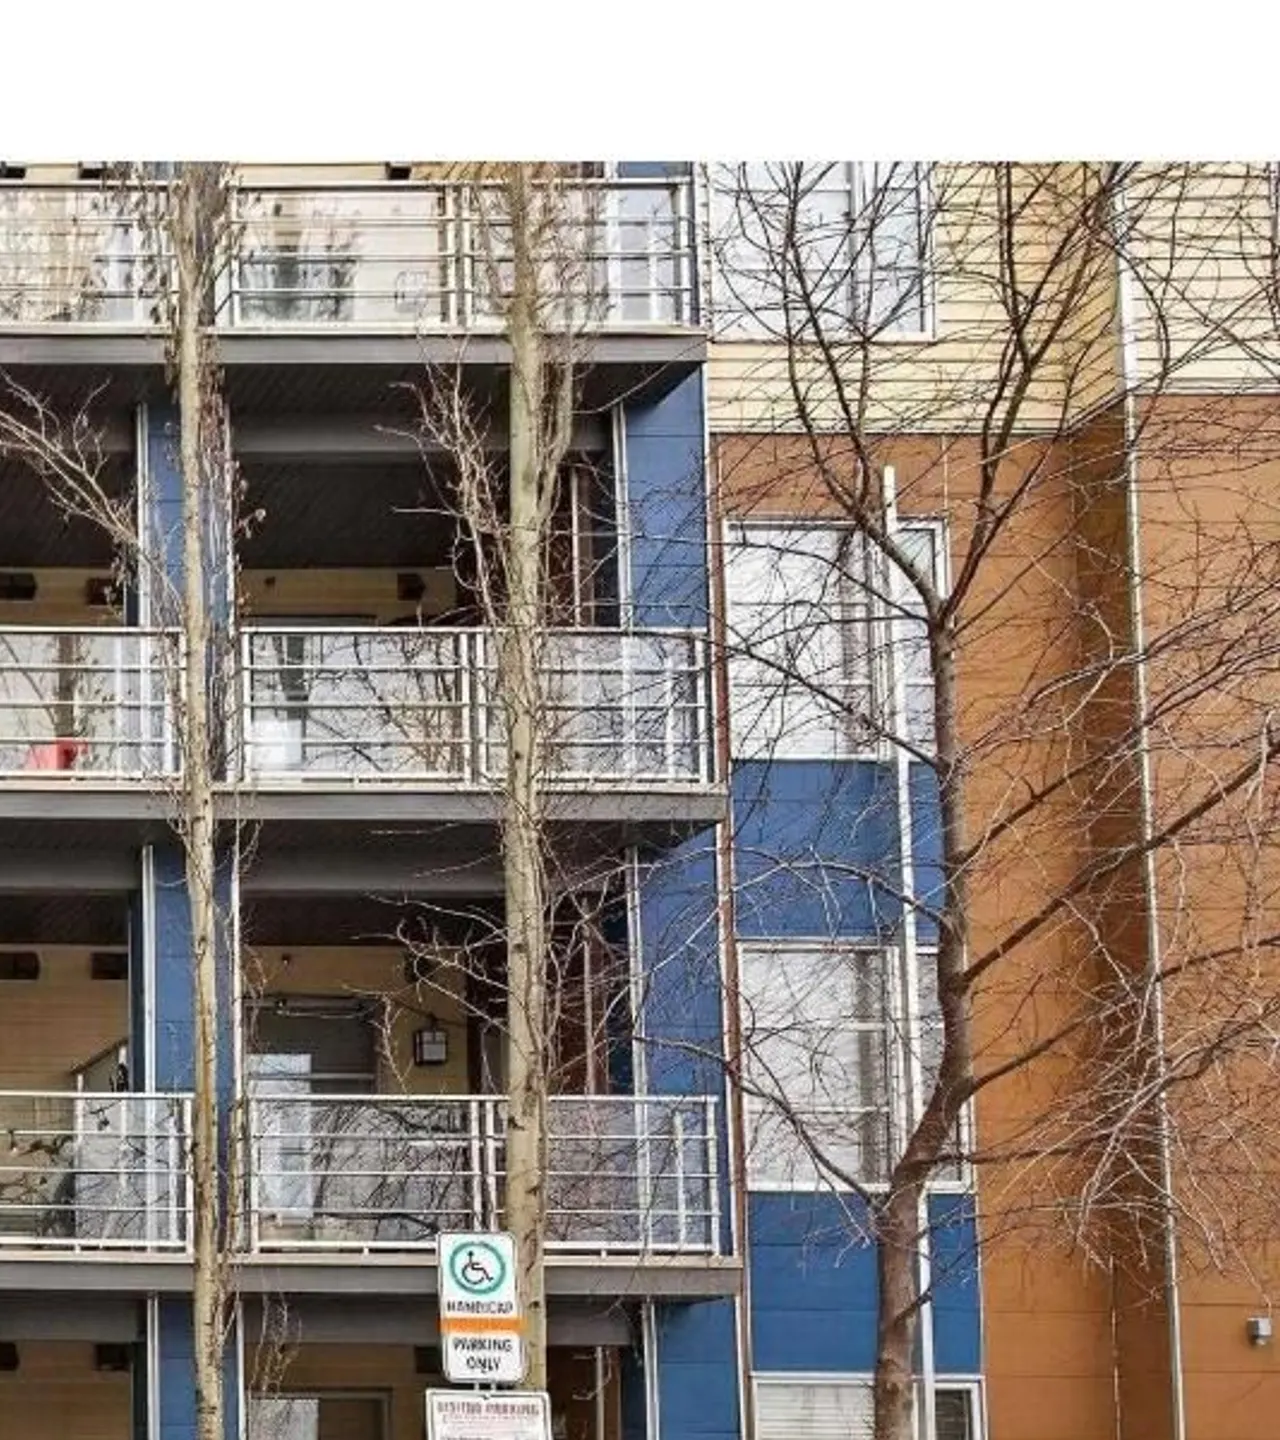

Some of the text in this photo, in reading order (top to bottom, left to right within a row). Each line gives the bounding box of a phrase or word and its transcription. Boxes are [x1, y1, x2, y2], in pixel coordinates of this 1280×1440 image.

[447, 1300, 513, 1314] HANDICAP
[453, 1338, 513, 1352] PARKING
[466, 1355, 502, 1372] ONLY
[485, 1402, 539, 1416] PARKING
